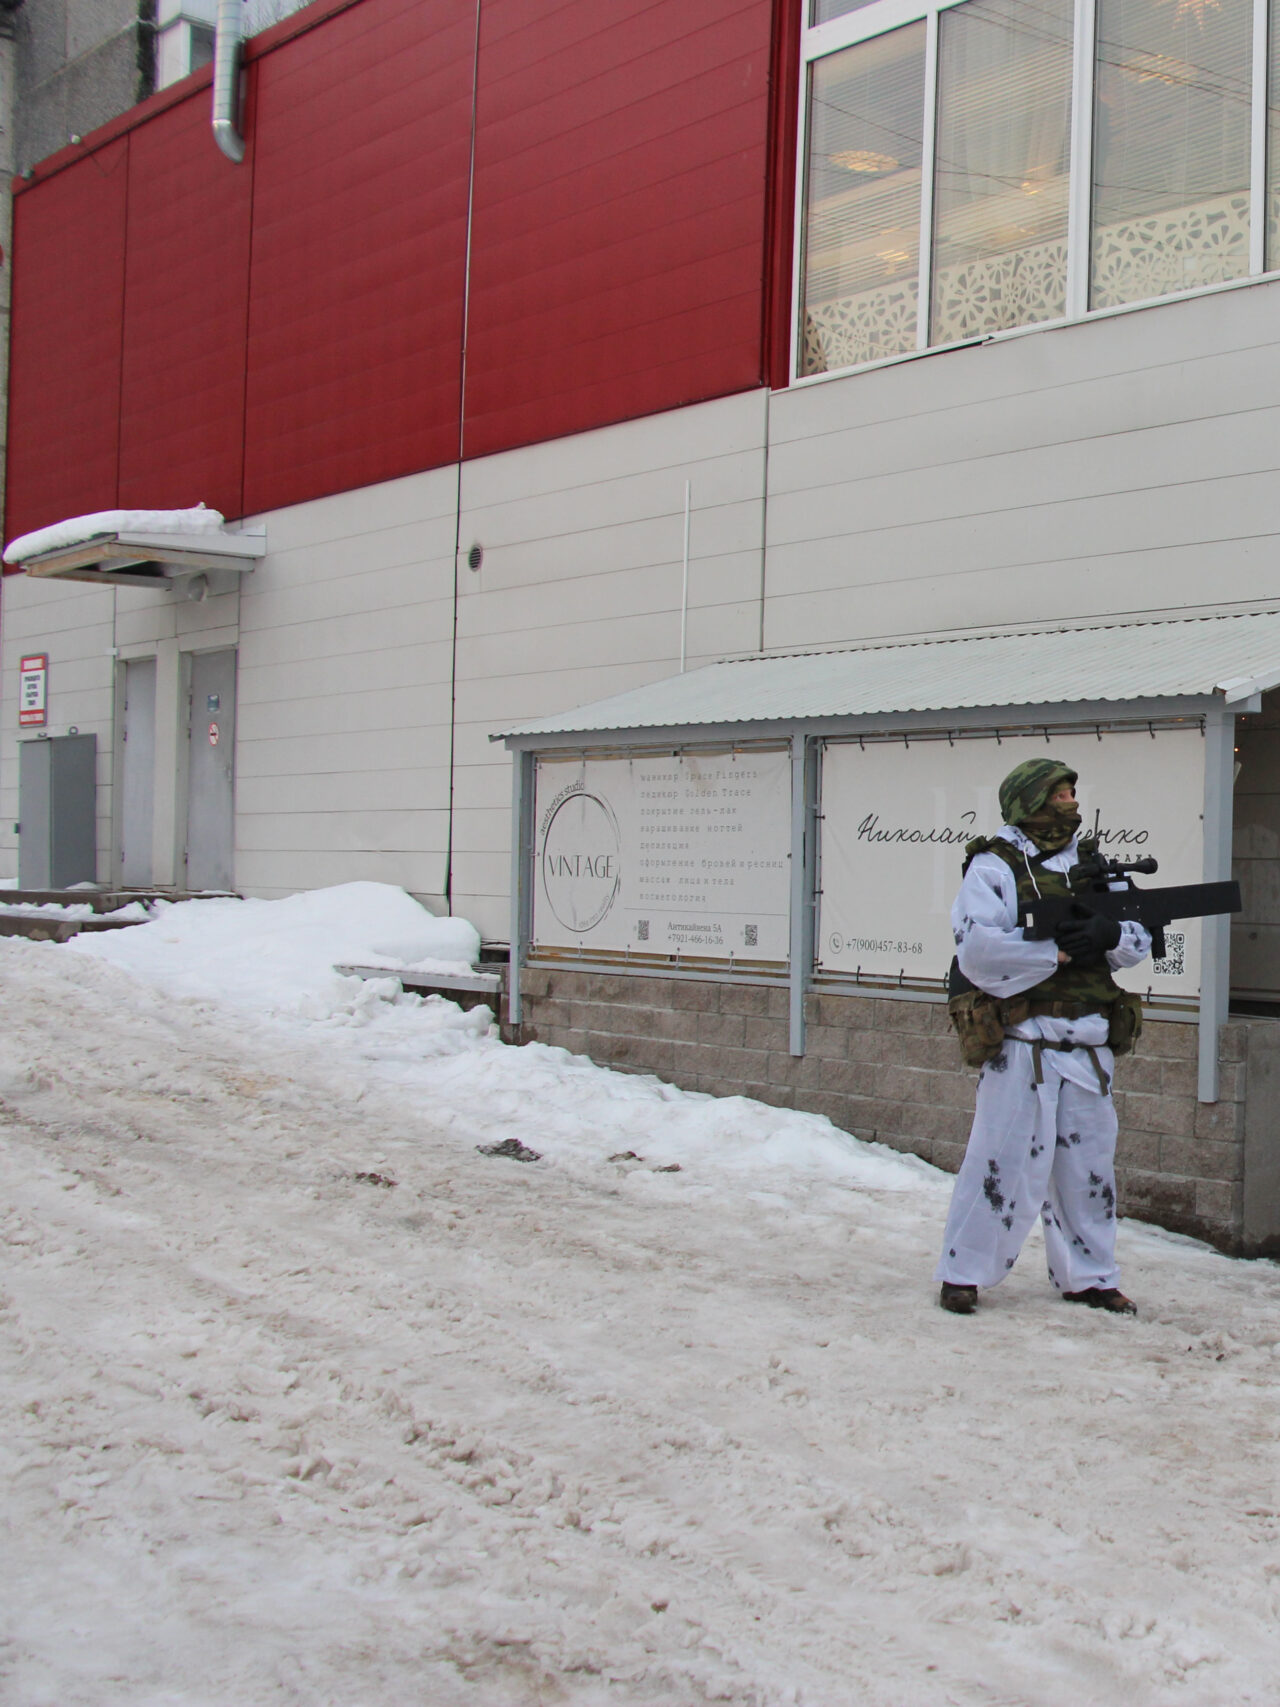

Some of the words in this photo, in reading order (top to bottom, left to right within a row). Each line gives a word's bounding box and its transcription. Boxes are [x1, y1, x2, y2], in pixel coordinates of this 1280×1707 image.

[716, 769, 758, 781] Fingers
[722, 788, 752, 797] Trace
[541, 790, 565, 836] aesthetics
[564, 780, 585, 795] studio
[707, 824, 743, 833] ногтей
[857, 811, 978, 843] Николай
[548, 855, 614, 879] VINTAGE
[701, 859, 737, 869] бровей
[667, 921, 712, 932] Антикайнена
[713, 924, 722, 933] 5А
[845, 938, 923, 954] +7(900)457-83-68
